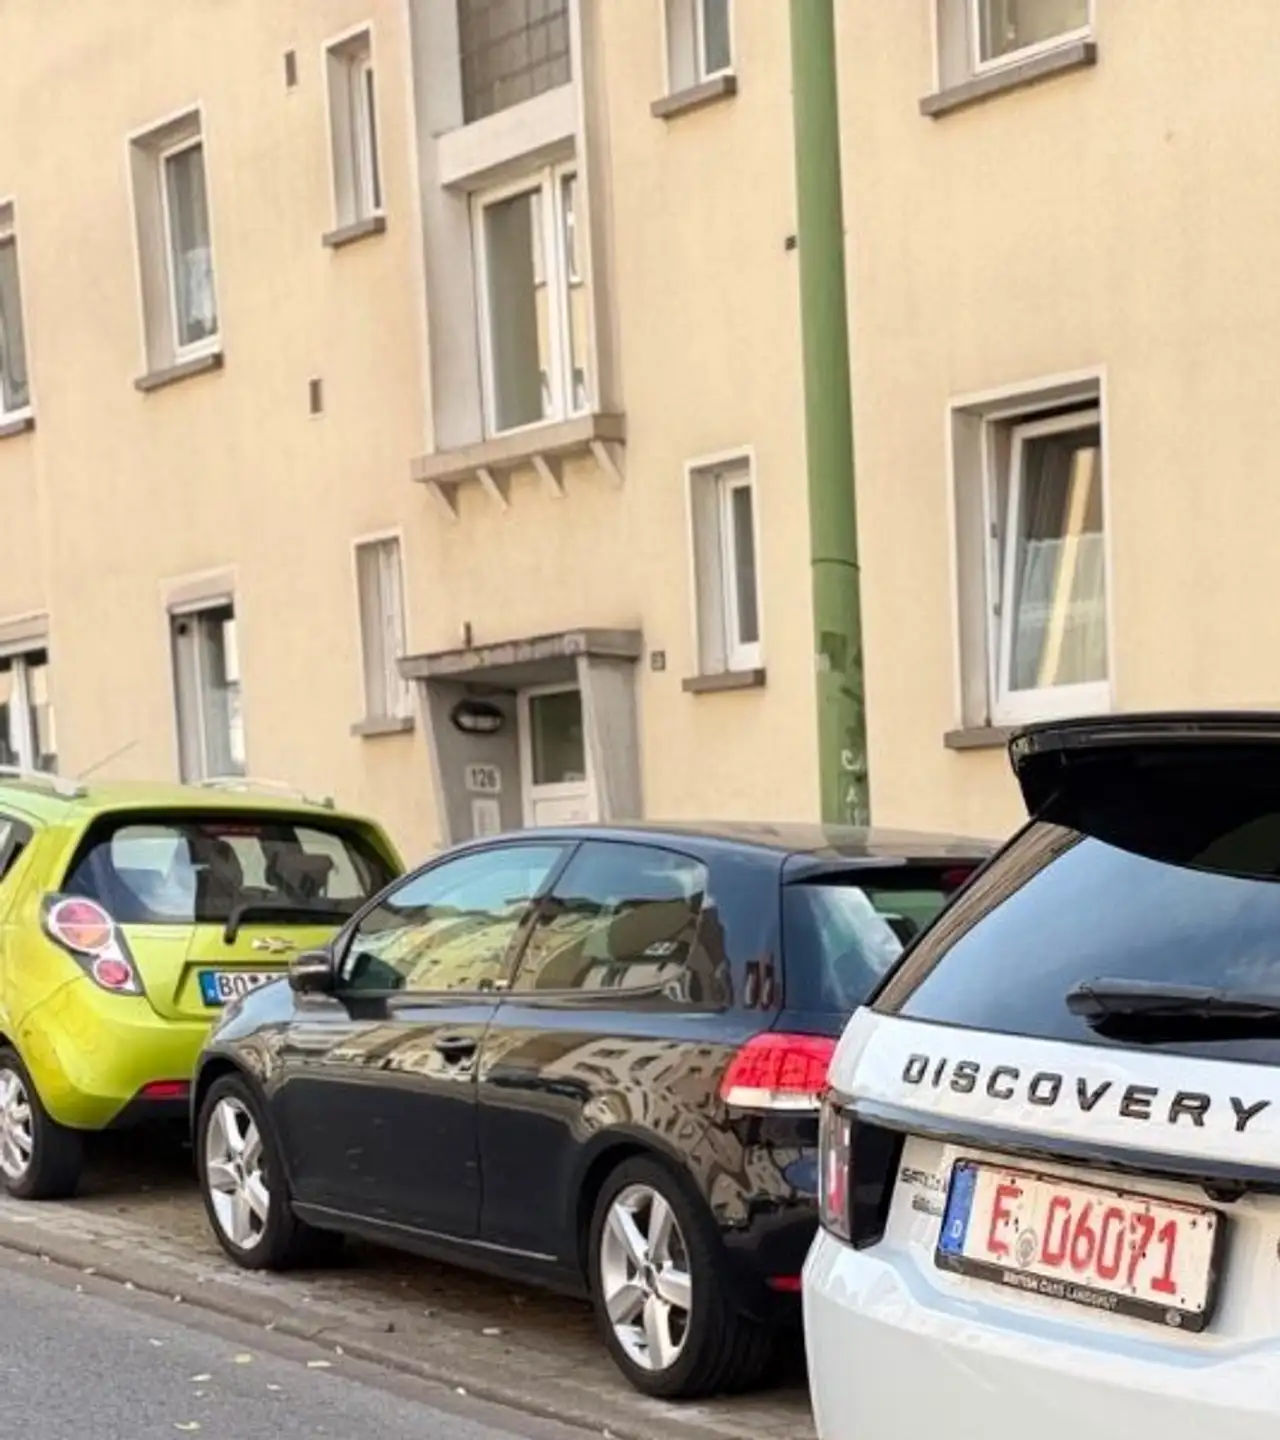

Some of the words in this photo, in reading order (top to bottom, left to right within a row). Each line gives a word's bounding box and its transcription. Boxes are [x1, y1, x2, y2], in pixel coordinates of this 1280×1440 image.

[901, 1053, 1271, 1133] DISCOVERY
[986, 1183, 1023, 1257] E
[1042, 1194, 1178, 1295] 06071
